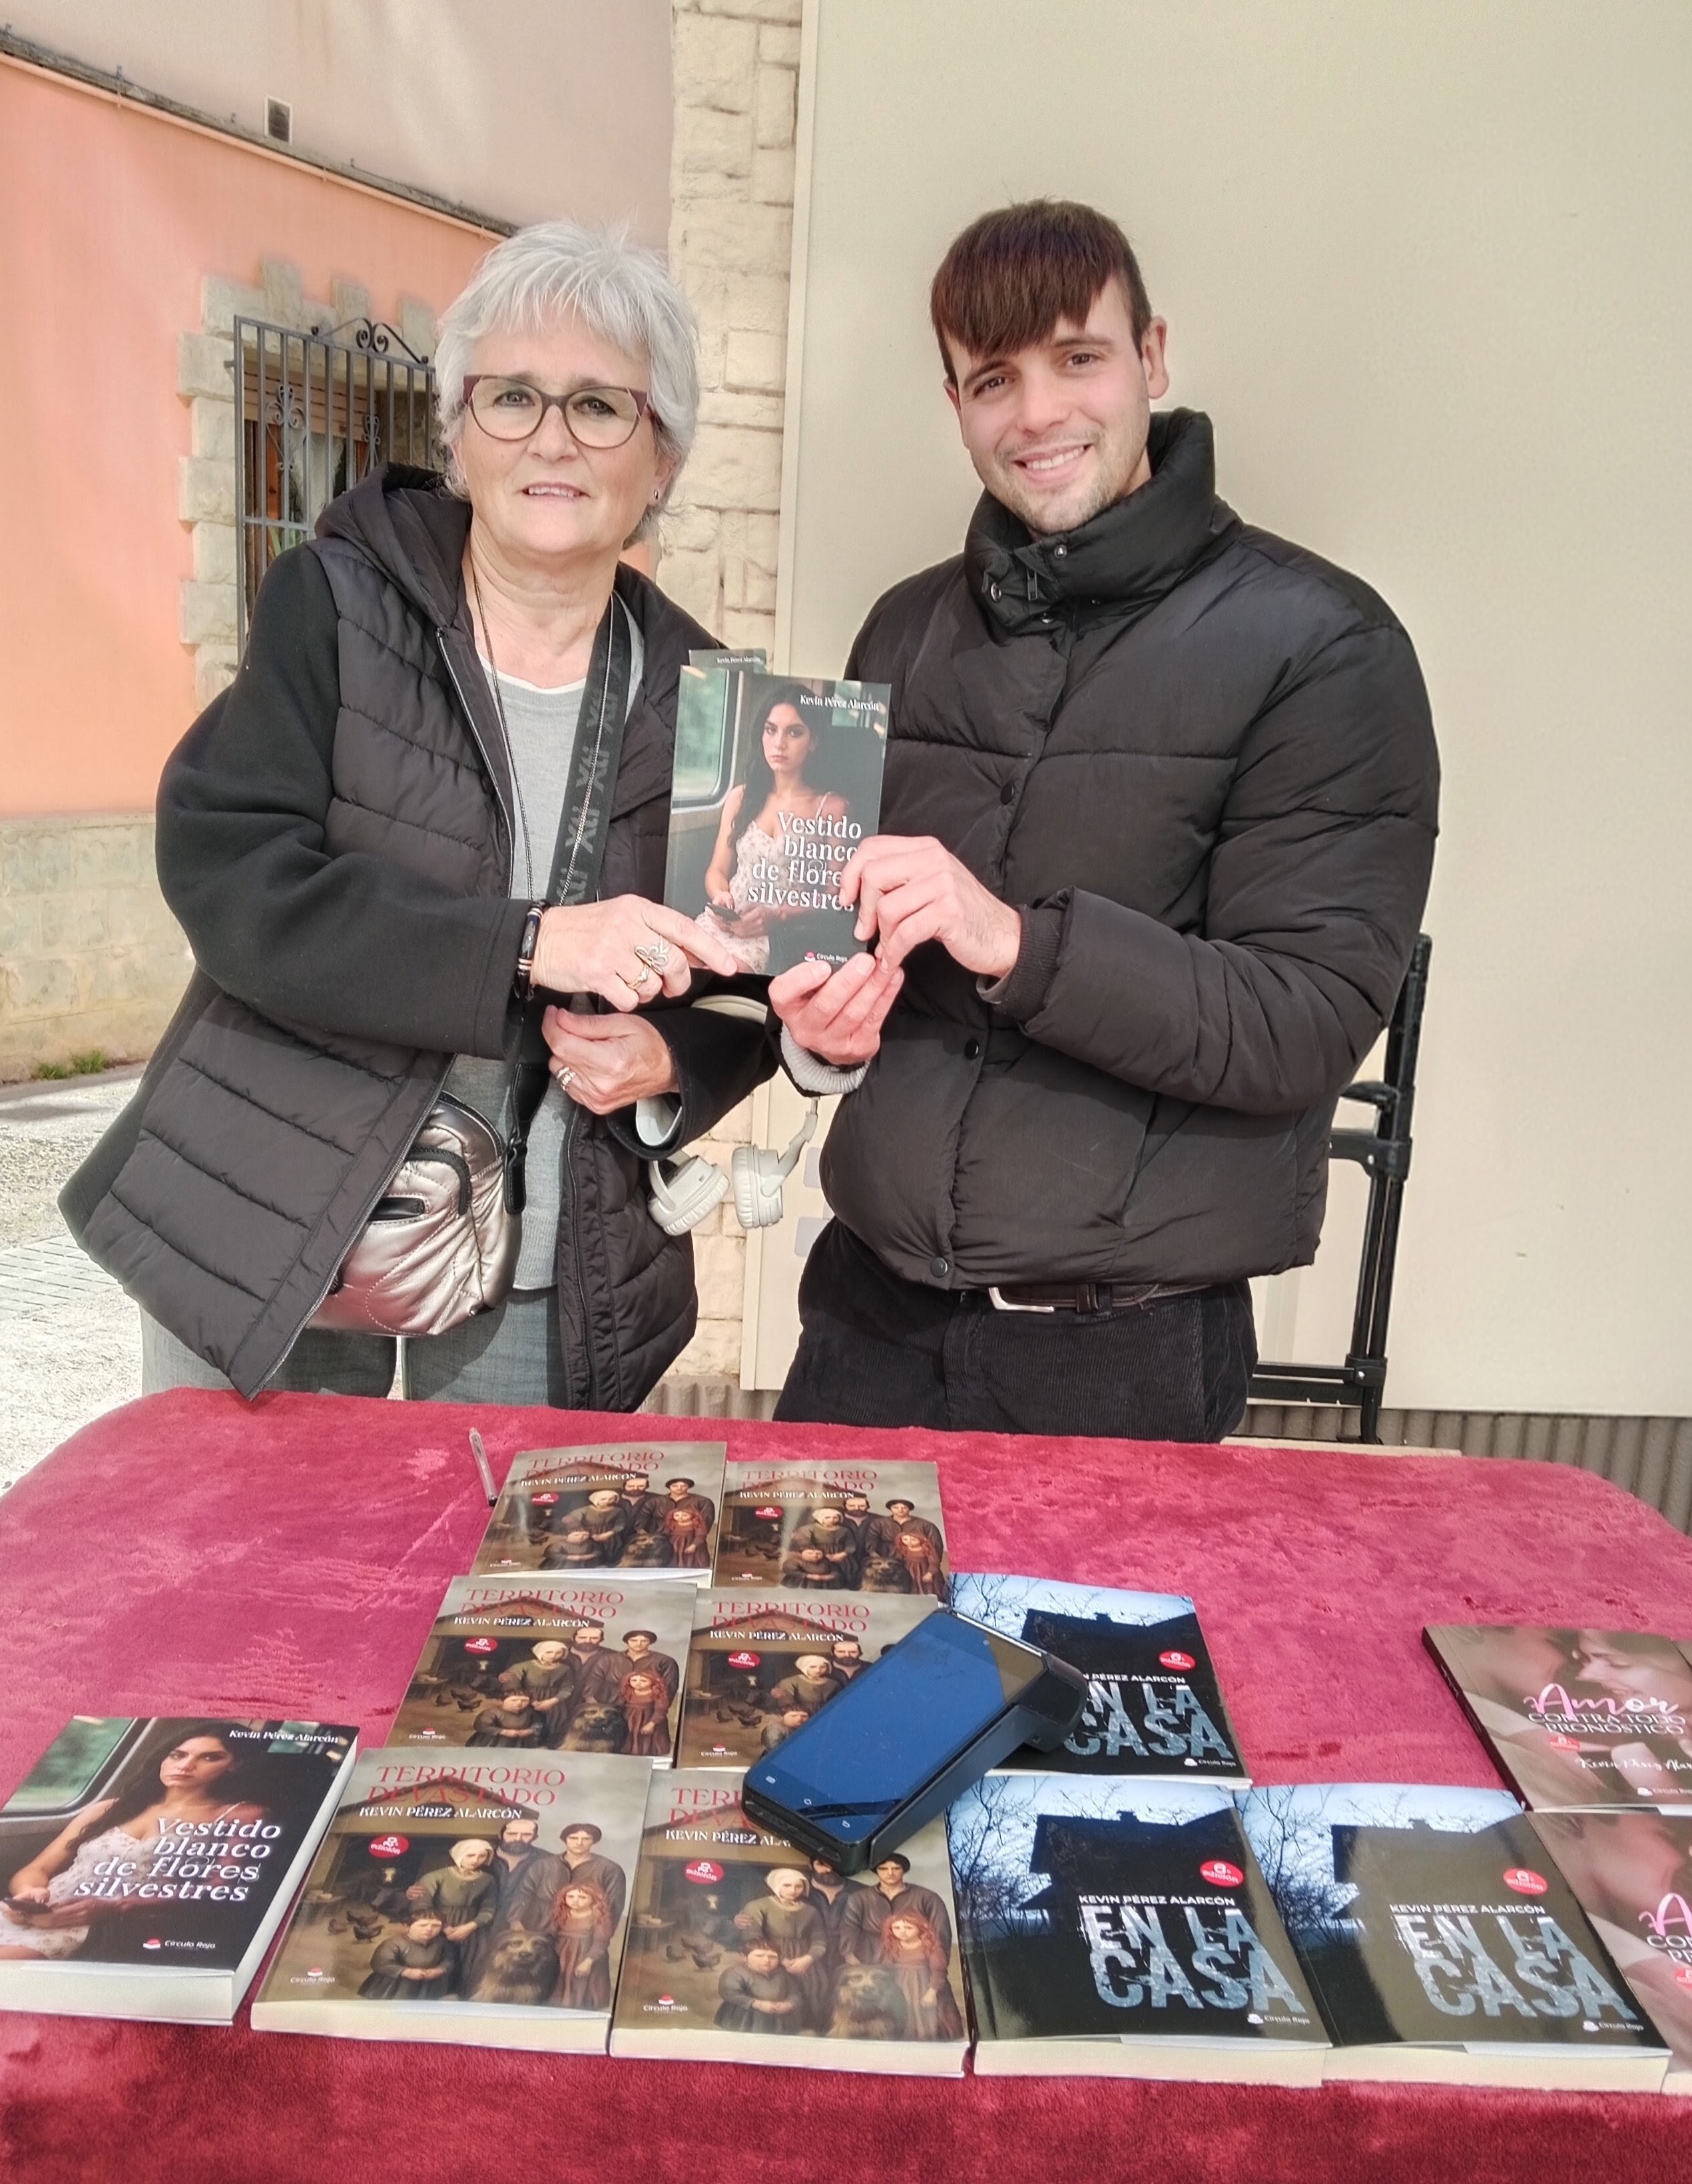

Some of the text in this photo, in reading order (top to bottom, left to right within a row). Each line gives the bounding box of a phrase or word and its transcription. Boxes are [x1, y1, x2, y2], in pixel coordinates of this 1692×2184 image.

[800, 695, 823, 707] Kevin
[778, 811, 862, 839] Vestido
[784, 835, 858, 862] blanco
[752, 857, 842, 887] de flore
[529, 1451, 665, 1469] TERRITORIO
[521, 1478, 551, 1487] KEVIN
[742, 1470, 878, 1480] TERRITORIO
[466, 1589, 624, 1605] TERRITORIO
[711, 1601, 870, 1619] TERRITORIO
[454, 1616, 490, 1625] KEVIN
[710, 1630, 745, 1639] KEVIN
[1092, 1672, 1129, 1682] PÉREZ
[1131, 1674, 1186, 1684] ALARCÓN
[1142, 1682, 1201, 1716] LA
[1524, 1683, 1679, 1722] Amor
[1529, 1712, 1620, 1724] CONTRA
[229, 1730, 260, 1739] Kevin
[376, 1766, 565, 1786] TERRITORIO
[368, 1785, 555, 1806] DEVASTADO
[360, 1804, 522, 1820] KEVIN PÉREZ ALARCÓN
[157, 1818, 281, 1839] Vestido
[666, 1829, 707, 1841] KEVIN
[712, 1830, 757, 1844] PÉREZ
[153, 1836, 271, 1859] blanco
[93, 1856, 259, 1880] de flores
[74, 1877, 249, 1901] silvestres
[1079, 1894, 1236, 1906] KEVIN PÉREZ ALARCÓN
[1390, 1903, 1546, 1914] KEVIN PÉREZ ALARCÓN
[1077, 1905, 1263, 1953] EN LA
[1392, 1914, 1575, 1962] EN LA
[1089, 1943, 1306, 2013] CASA
[1413, 1954, 1638, 2020] CASA
